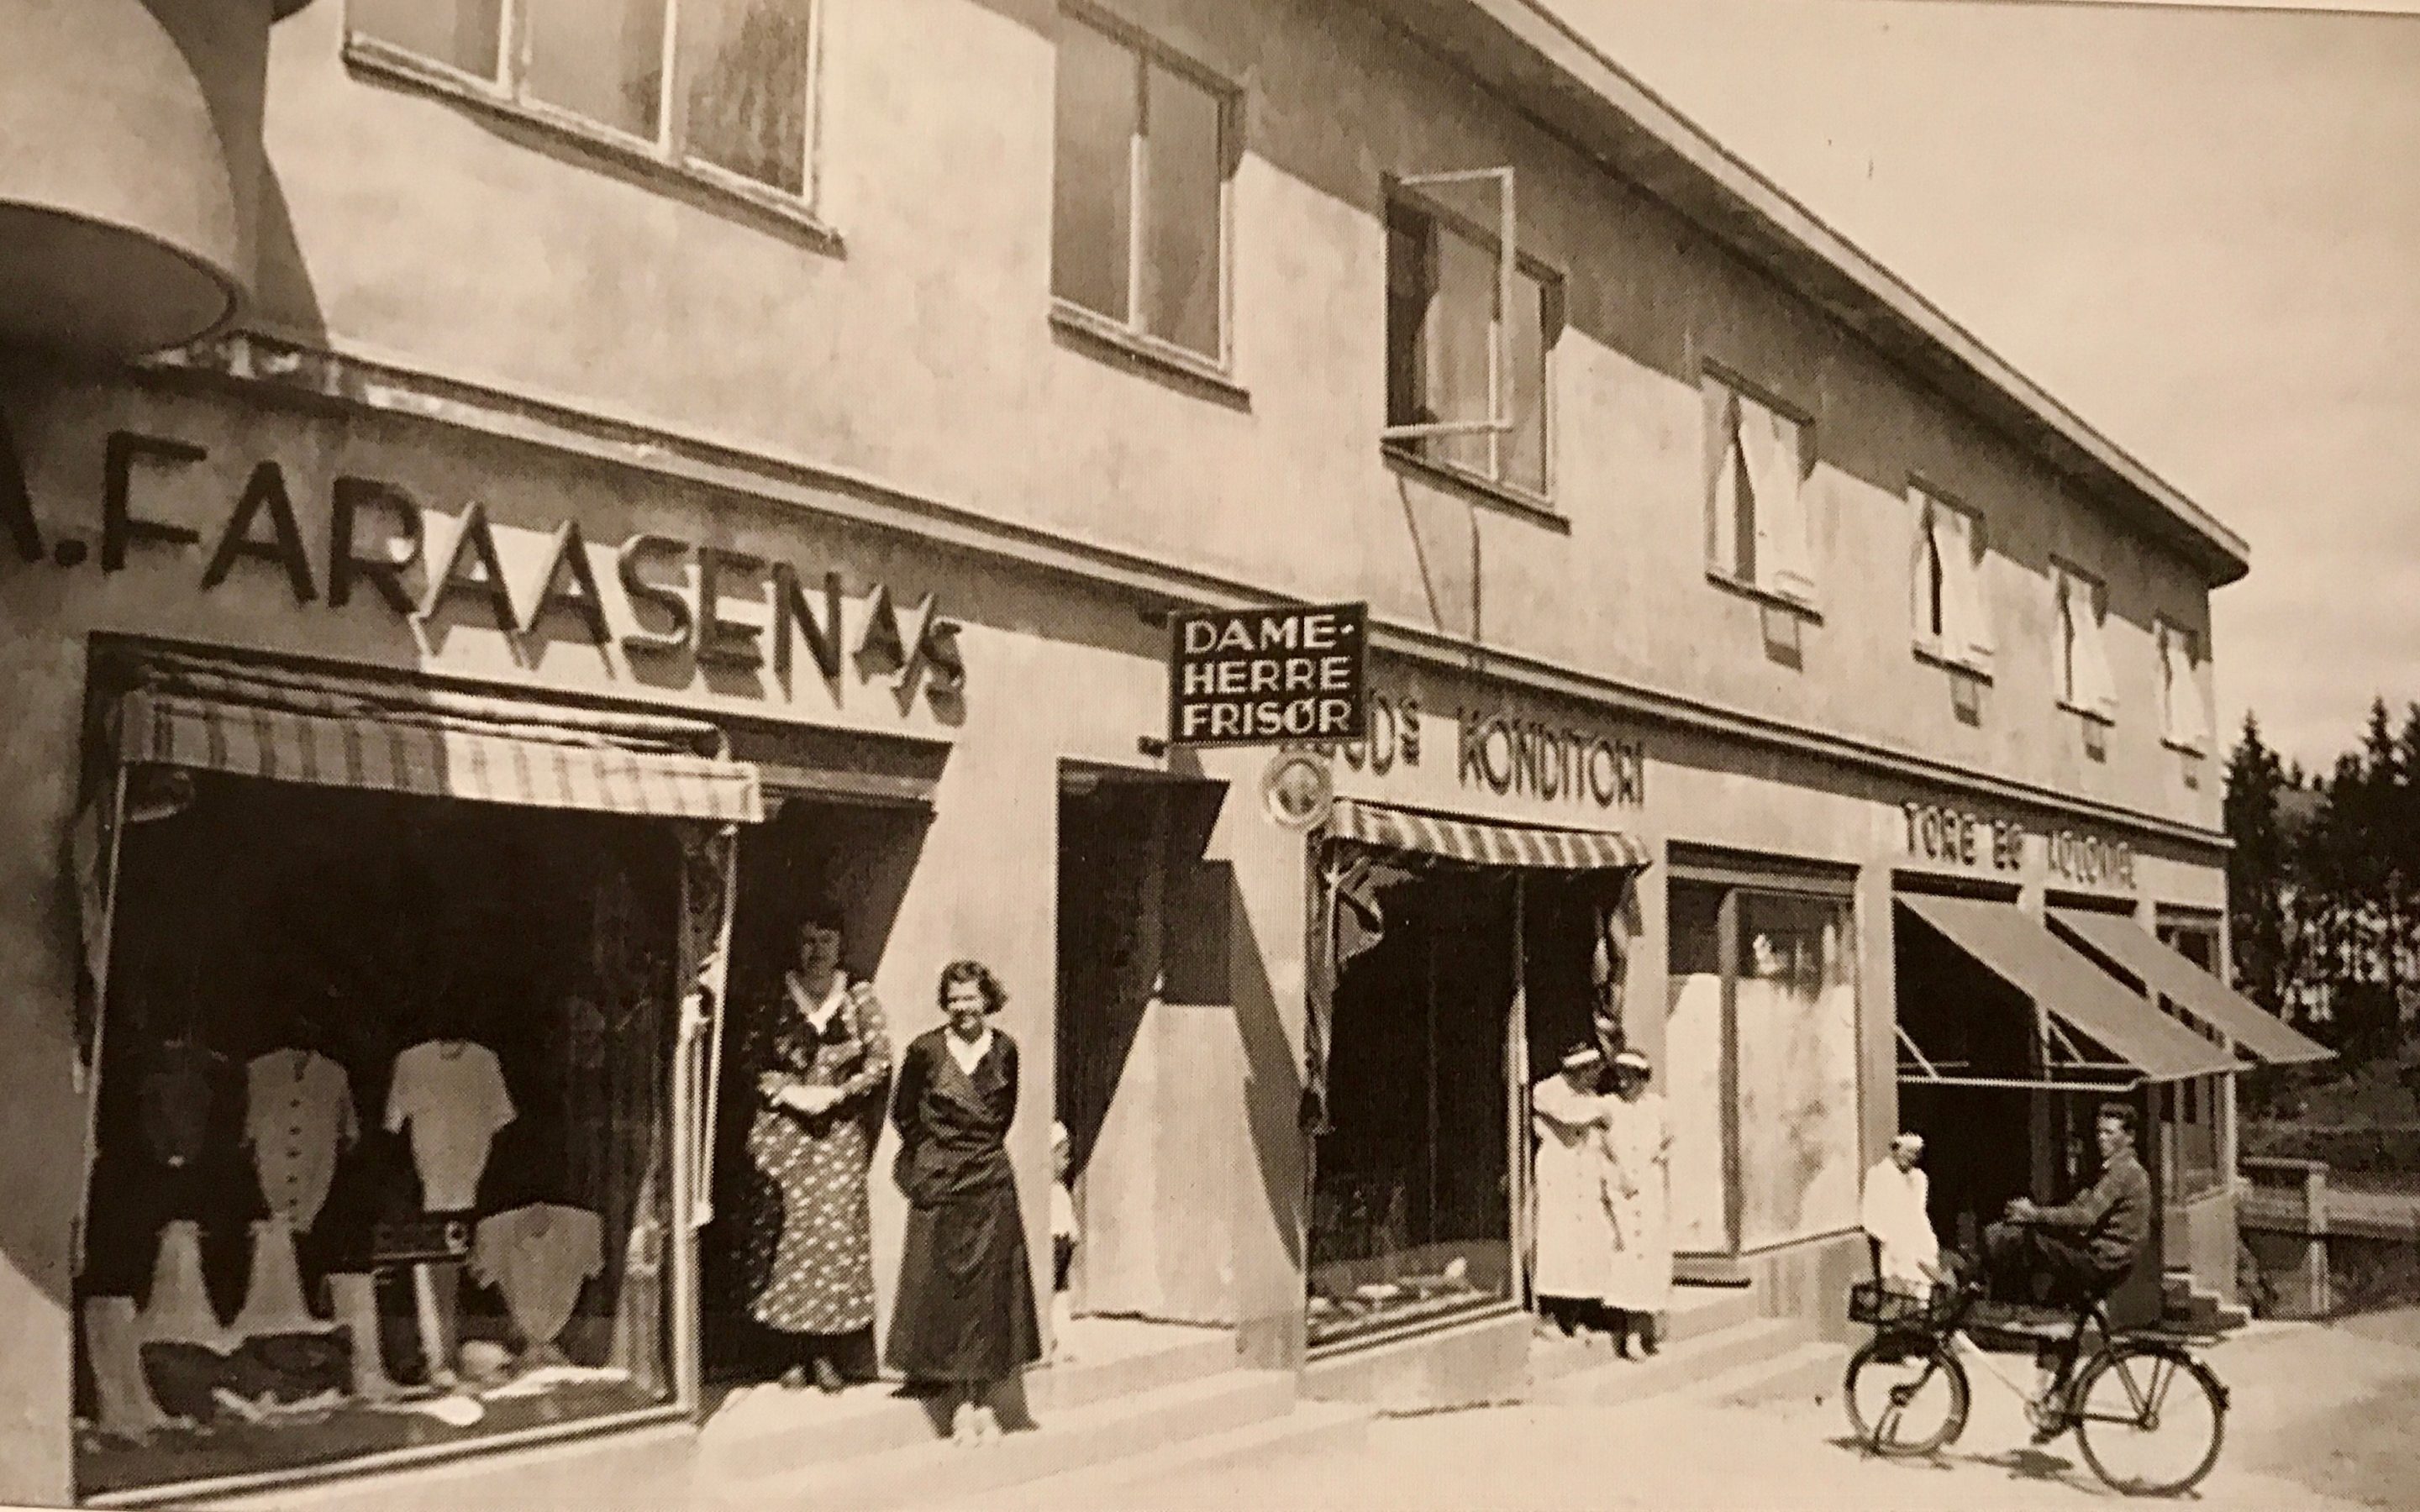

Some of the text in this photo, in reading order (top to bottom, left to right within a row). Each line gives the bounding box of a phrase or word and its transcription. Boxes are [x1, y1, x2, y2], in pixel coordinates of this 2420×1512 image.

[1183, 656, 1351, 696] HERRE
[1183, 696, 1352, 738] FRISØR
[1457, 706, 1644, 811] KONDITORI
